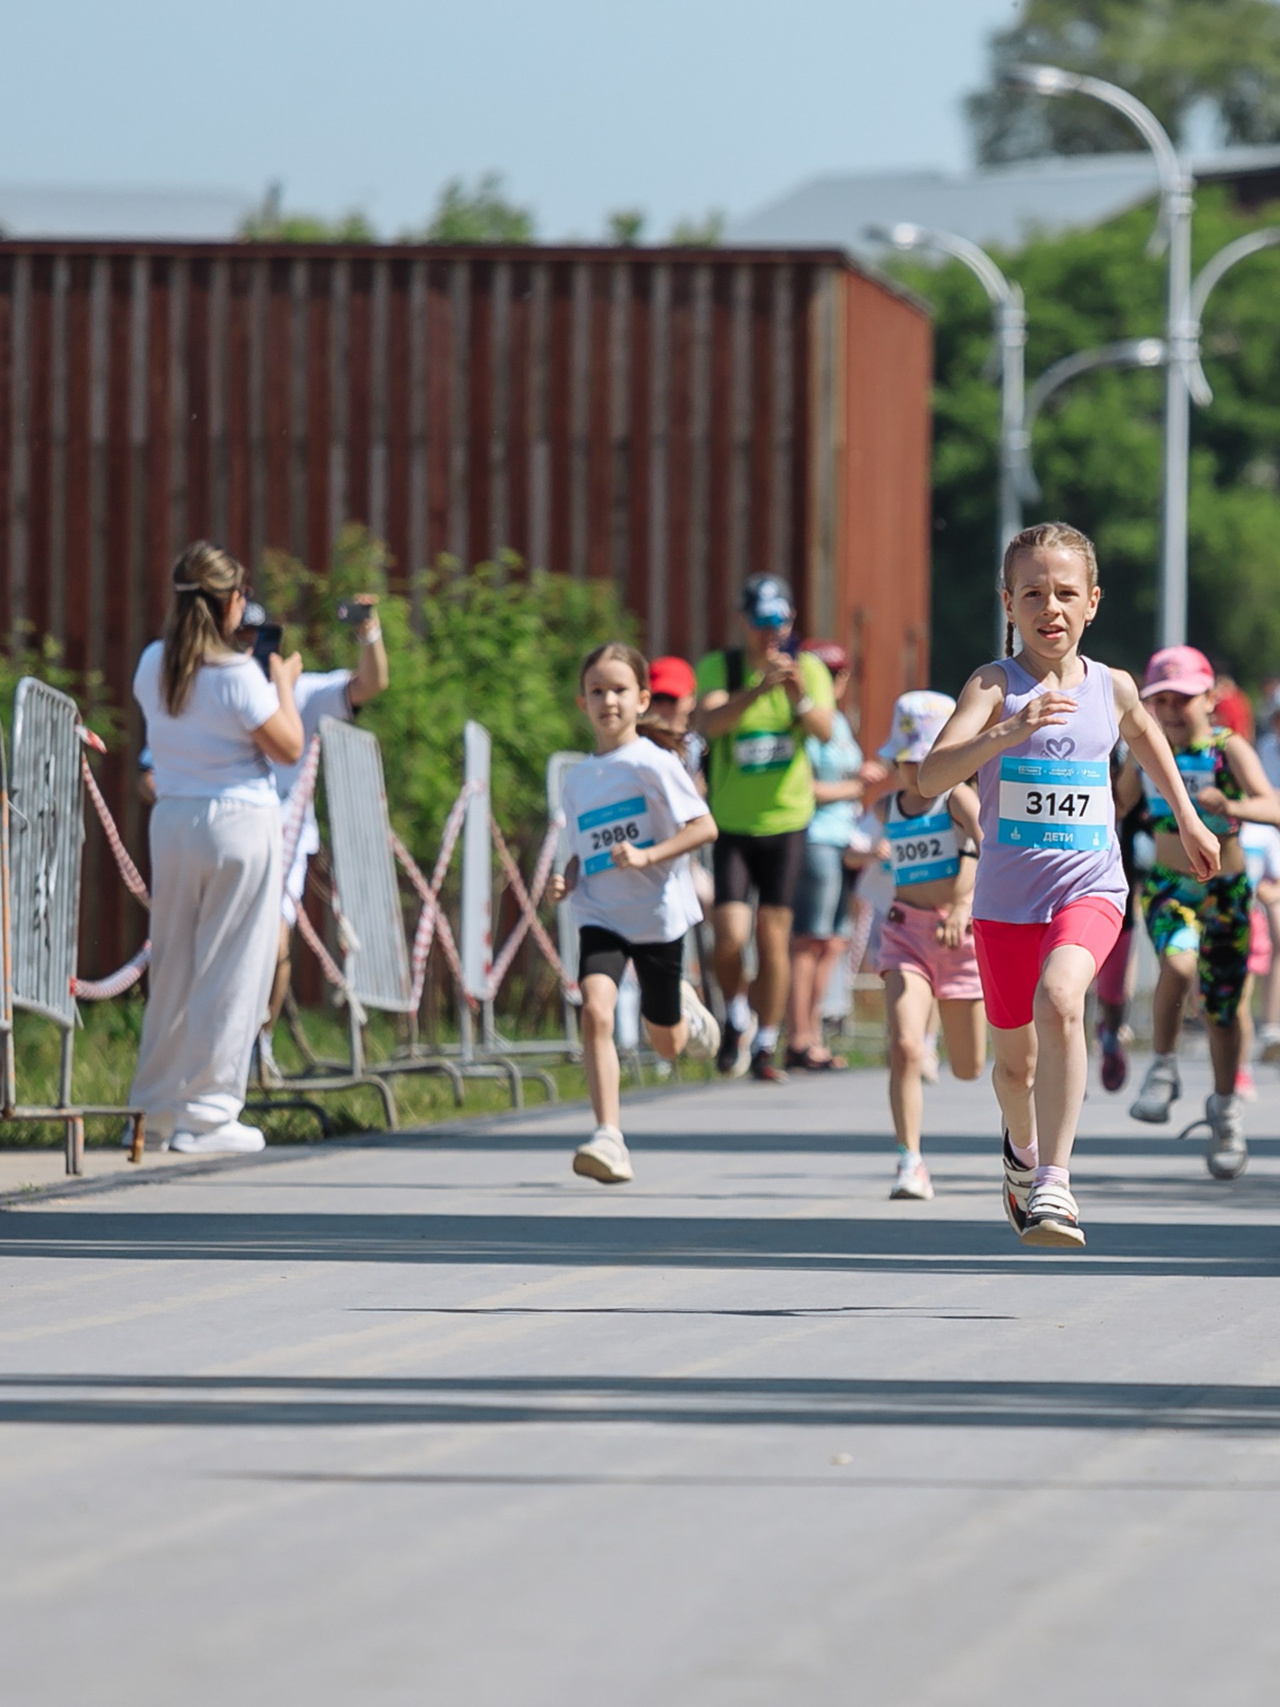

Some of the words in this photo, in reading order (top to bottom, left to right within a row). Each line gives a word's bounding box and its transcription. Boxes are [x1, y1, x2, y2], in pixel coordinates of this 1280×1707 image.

[1025, 791, 1090, 817] 3147
[591, 821, 640, 850] 2986
[1043, 832, 1074, 843] ДЕТИ
[896, 839, 944, 863] 3092
